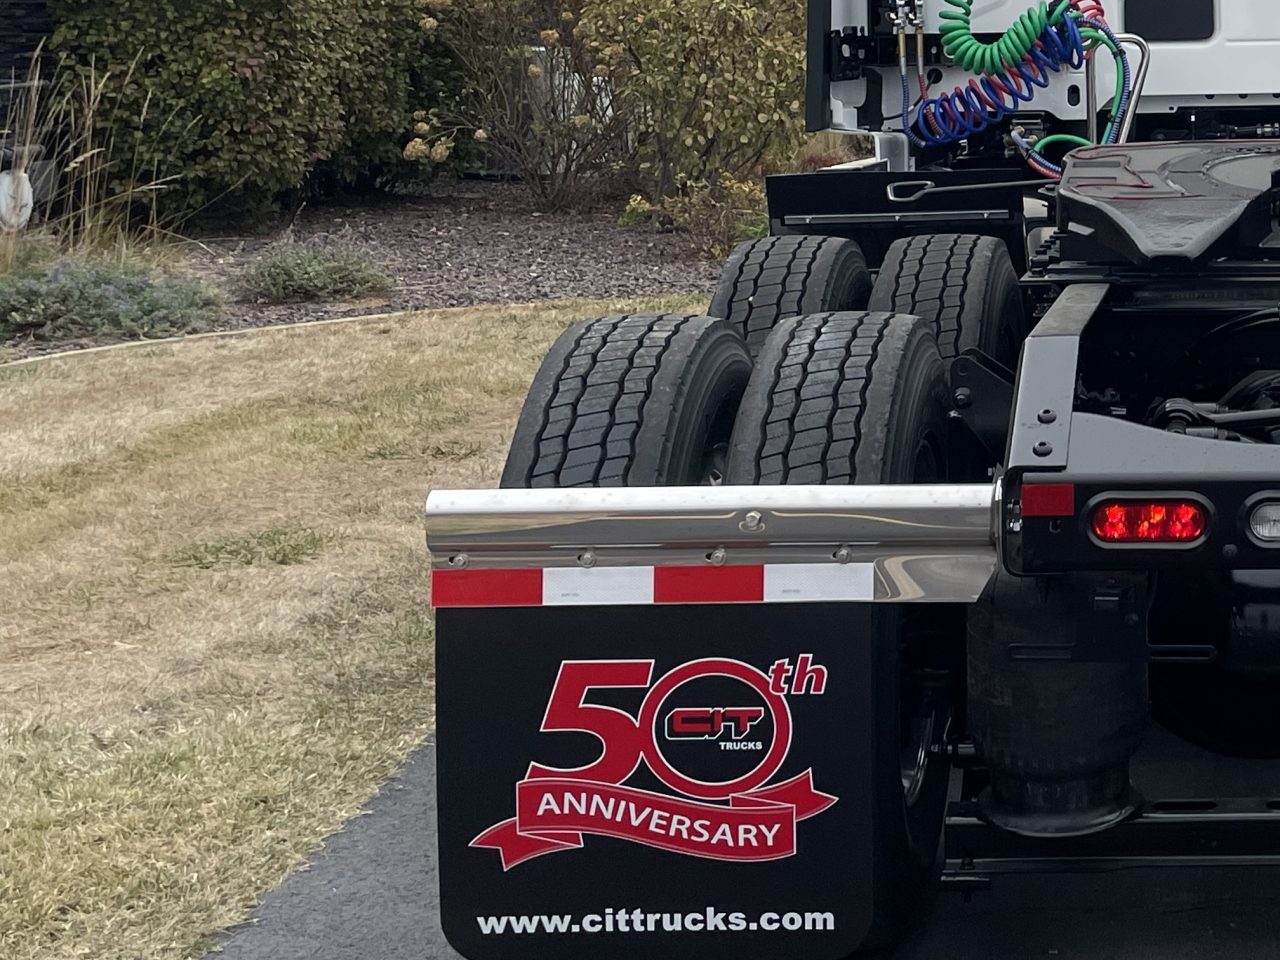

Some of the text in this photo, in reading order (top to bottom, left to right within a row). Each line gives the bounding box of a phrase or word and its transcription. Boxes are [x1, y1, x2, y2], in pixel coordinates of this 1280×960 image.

[665, 707, 764, 739] CIT
[719, 741, 763, 751] TRUCKS
[537, 792, 781, 847] ANNIVERSARY
[476, 907, 835, 934] www.cittrucks.com
